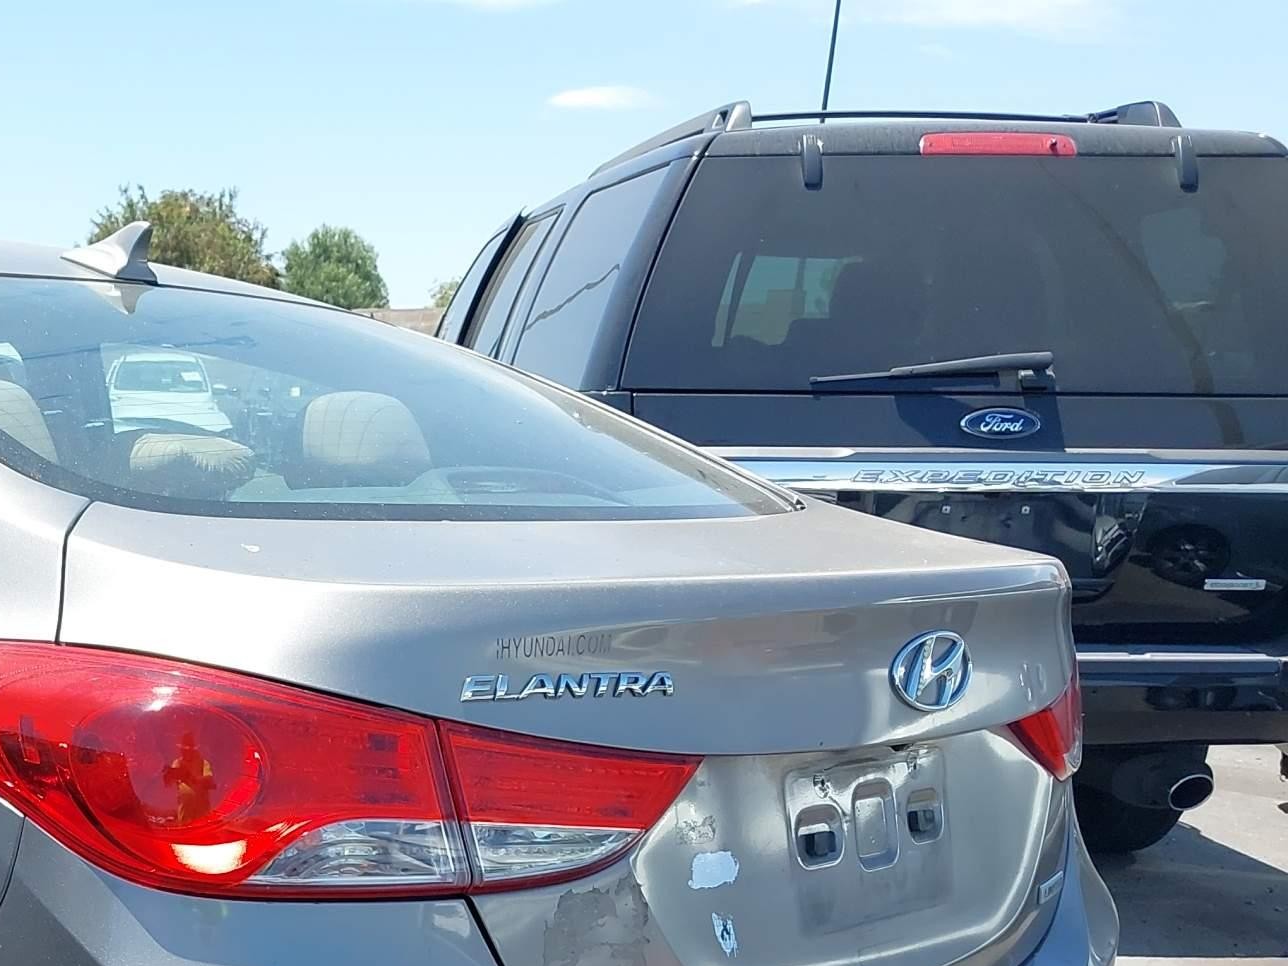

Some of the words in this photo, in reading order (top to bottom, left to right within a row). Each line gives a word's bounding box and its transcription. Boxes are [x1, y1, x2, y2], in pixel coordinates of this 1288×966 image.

[980, 413, 1024, 432] Ford
[851, 469, 1145, 488] EXPEDITION
[460, 671, 674, 702] ELANTRA
